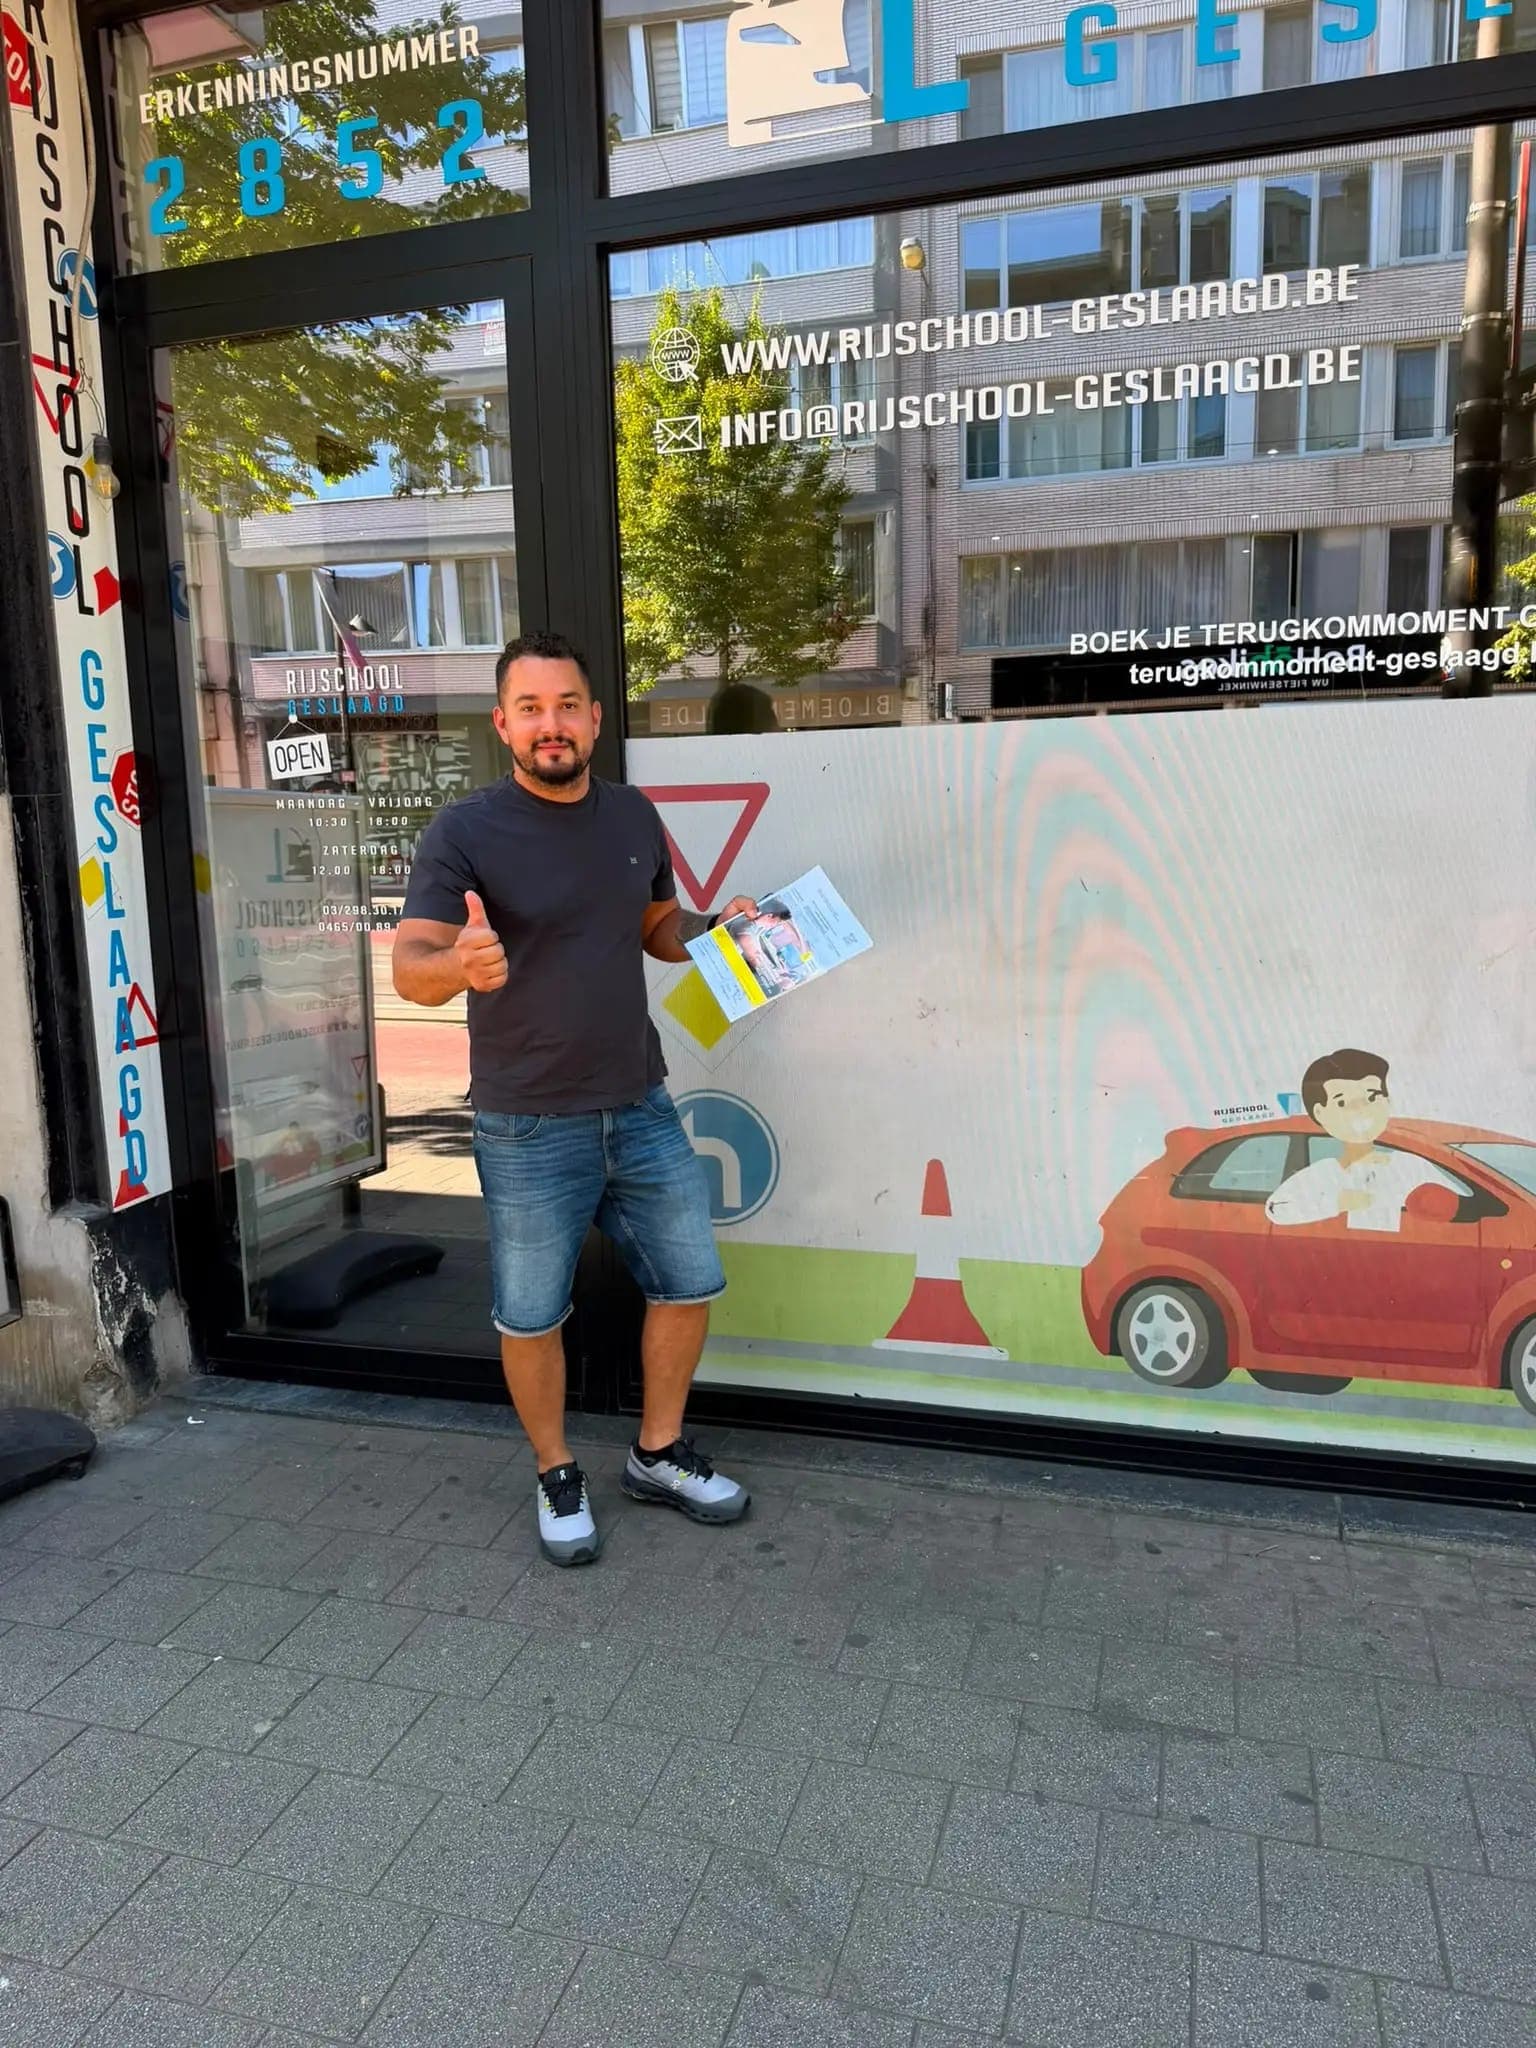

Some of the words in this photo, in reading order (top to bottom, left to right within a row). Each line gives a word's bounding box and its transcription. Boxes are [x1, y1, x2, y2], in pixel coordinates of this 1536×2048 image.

[139, 25, 481, 125] ERKENNINGSNUMMER
[720, 264, 1360, 376] WWW.RIJSCHOOL-GESLAAGD.BE
[720, 345, 1361, 449] INFO@RIJSCHOOL-GESLAAGD.BE
[1070, 628, 1149, 655] BOEK
[1156, 626, 1191, 650] JE
[1199, 606, 1511, 646] TERUGKOMMOMENT
[286, 664, 404, 694] RIJSCHOOL
[288, 694, 405, 716] GESLAAGD
[274, 740, 326, 773] OPEN
[368, 796, 433, 808] VRIJDAG
[309, 817, 347, 828] 10:30
[368, 816, 408, 826] 18:00
[323, 845, 398, 856] ZATERDAG
[312, 865, 351, 876] 12.00
[80, 648, 149, 1187] GESLAAGD
[318, 922, 401, 933] 0465/00.89.
